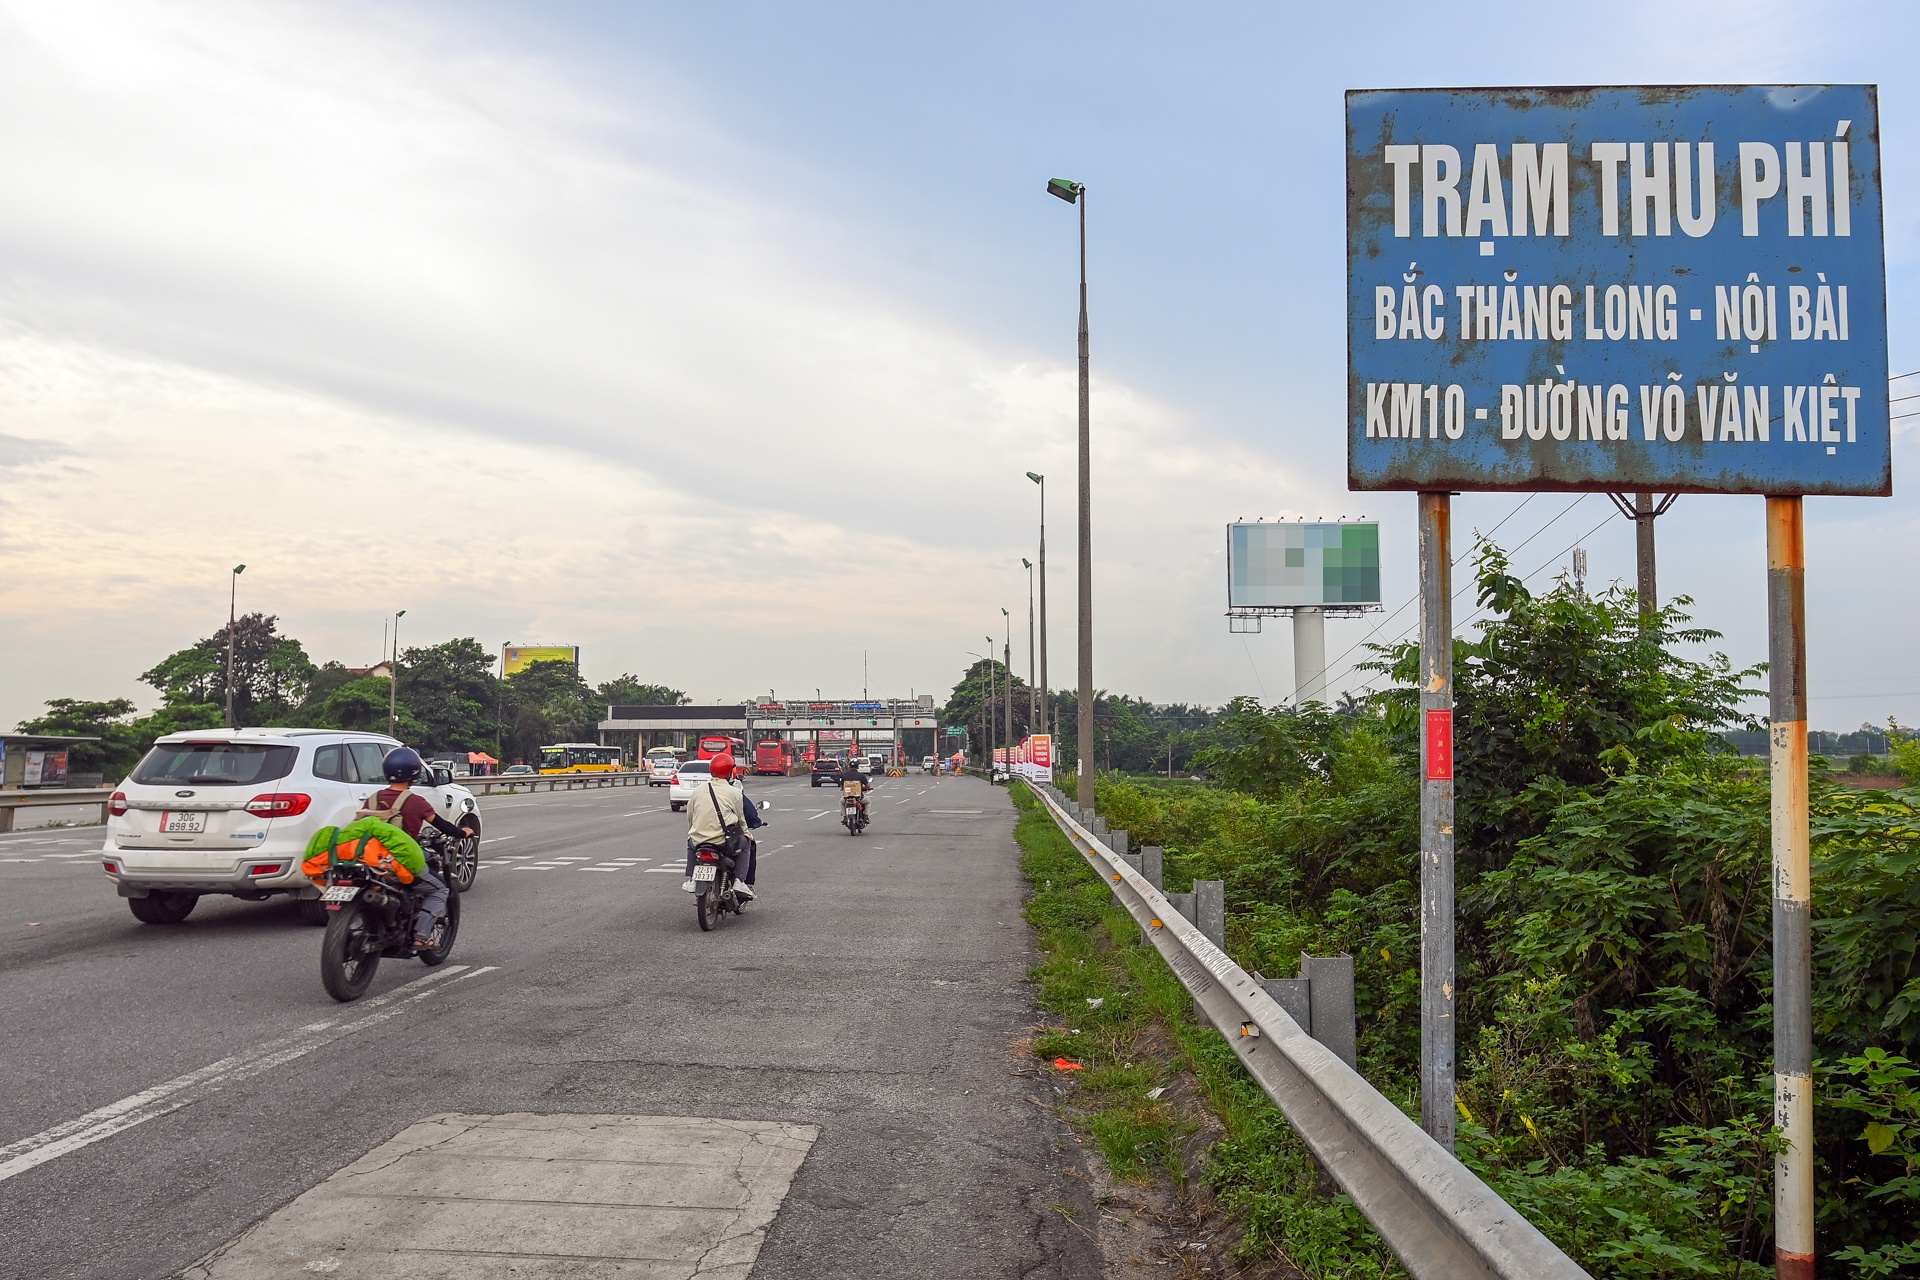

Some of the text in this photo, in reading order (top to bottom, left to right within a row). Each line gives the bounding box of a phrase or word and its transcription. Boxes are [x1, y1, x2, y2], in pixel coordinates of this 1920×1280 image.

[1384, 119, 1852, 256] TRẠM THU PHÍ
[1375, 261, 1849, 354] BẮC THĂNG LONG - NỘI BÀI
[1365, 364, 1861, 455] KM10 - ĐƯỜNG VÕ VĂN KIỆT
[169, 822, 200, 831] 898.92
[178, 813, 195, 822] 30G
